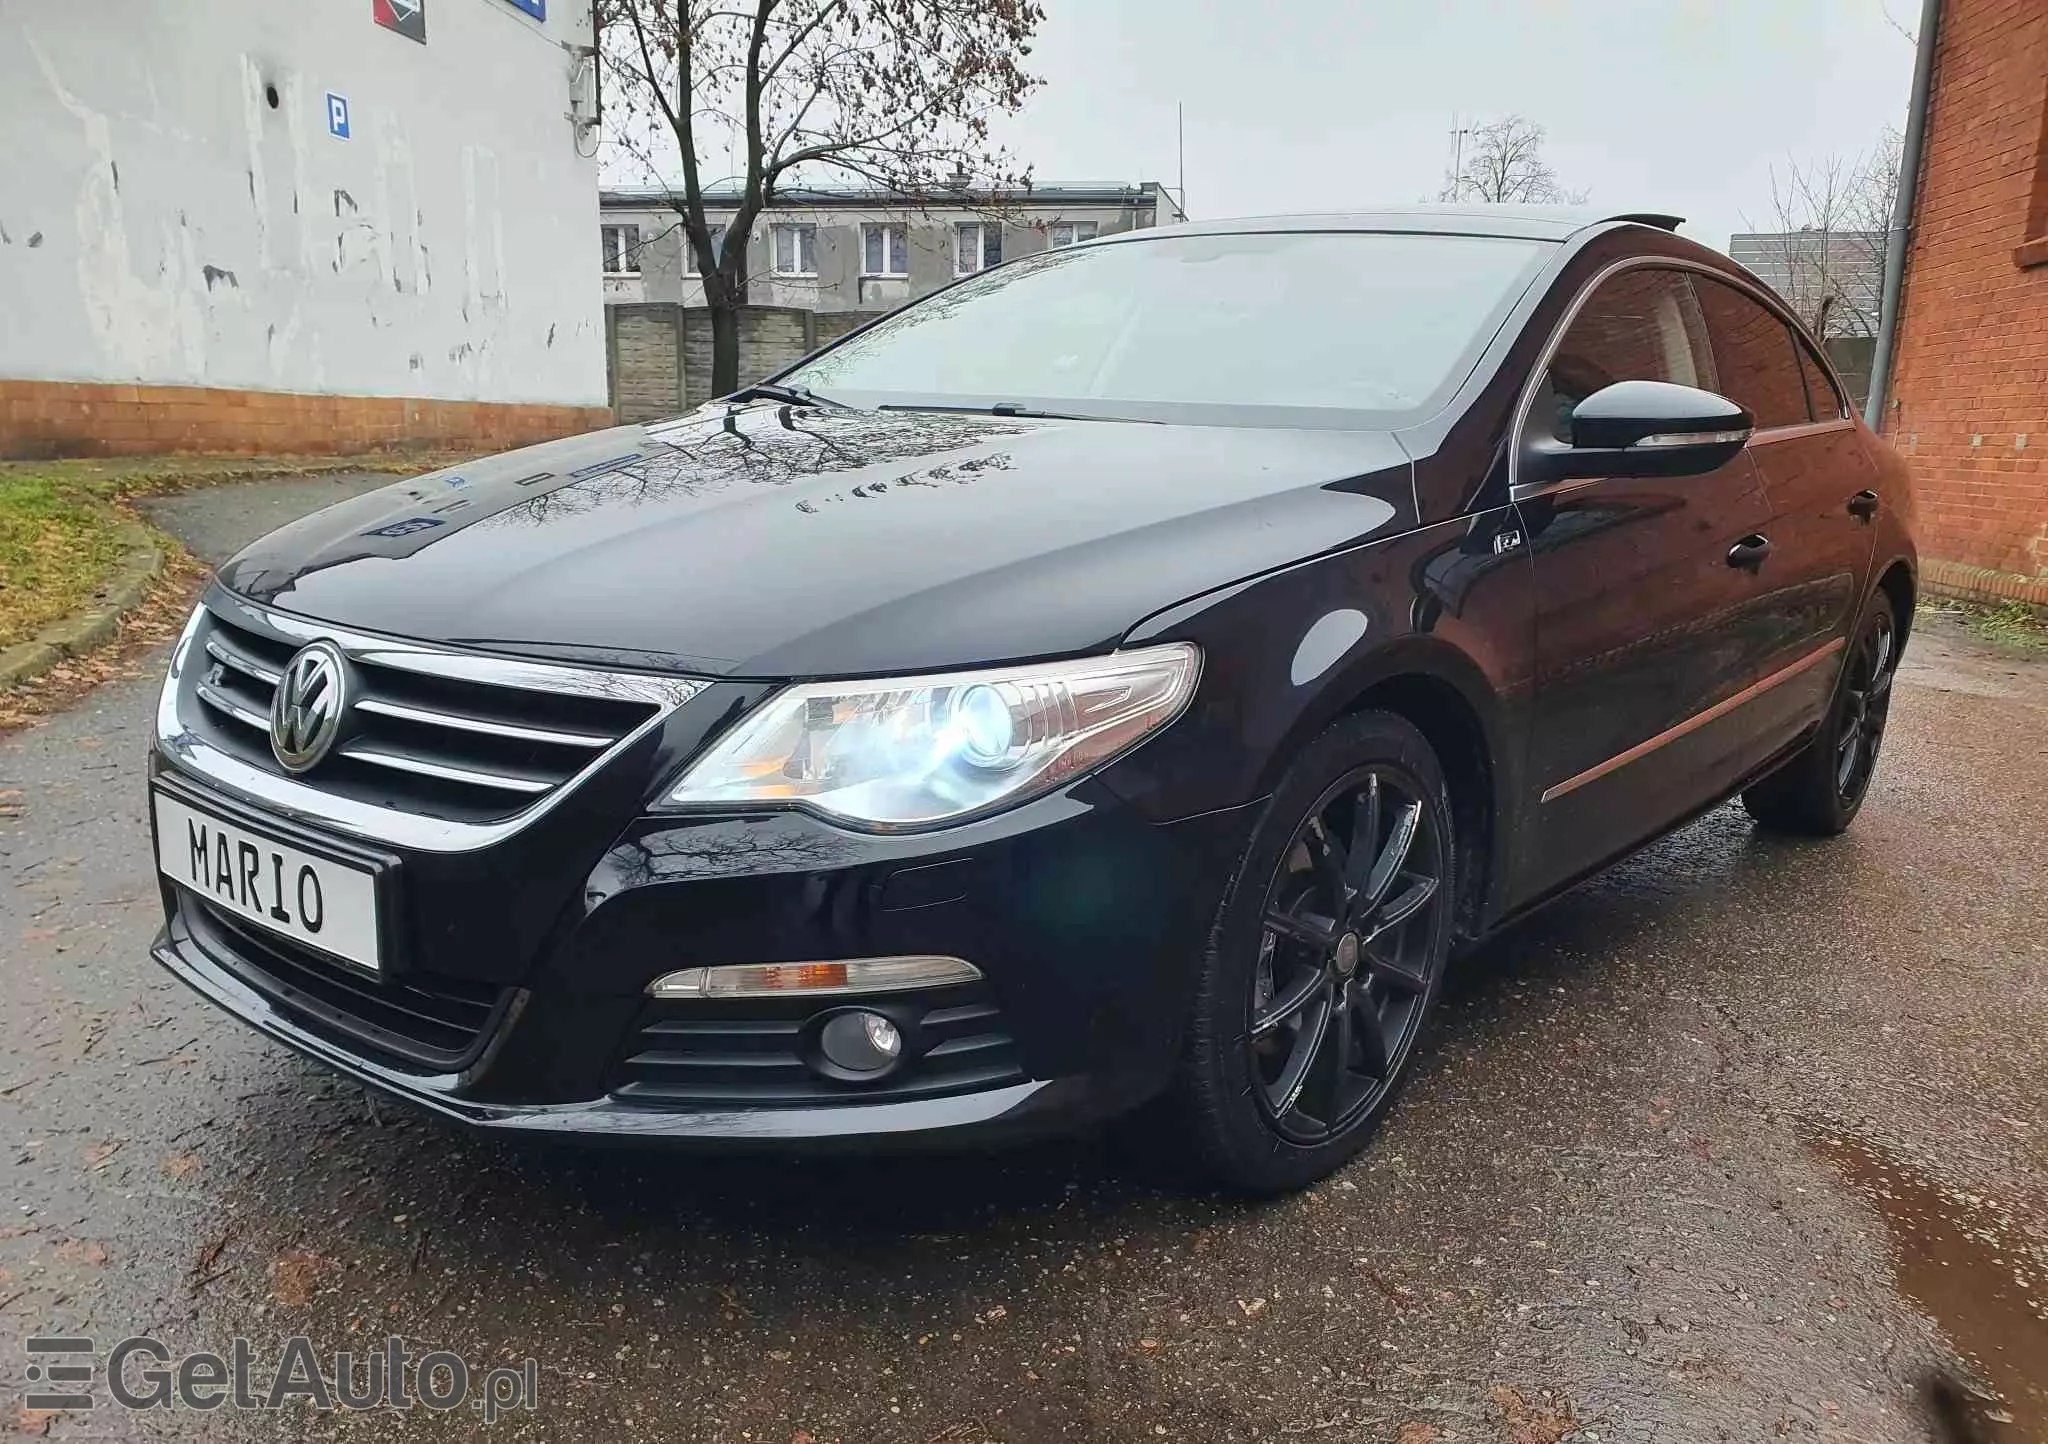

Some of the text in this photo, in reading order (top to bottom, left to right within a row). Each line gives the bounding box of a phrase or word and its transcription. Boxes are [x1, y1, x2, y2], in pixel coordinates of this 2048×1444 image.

[331, 98, 345, 131] P
[271, 645, 343, 764] VW
[188, 818, 323, 934] MARIO
